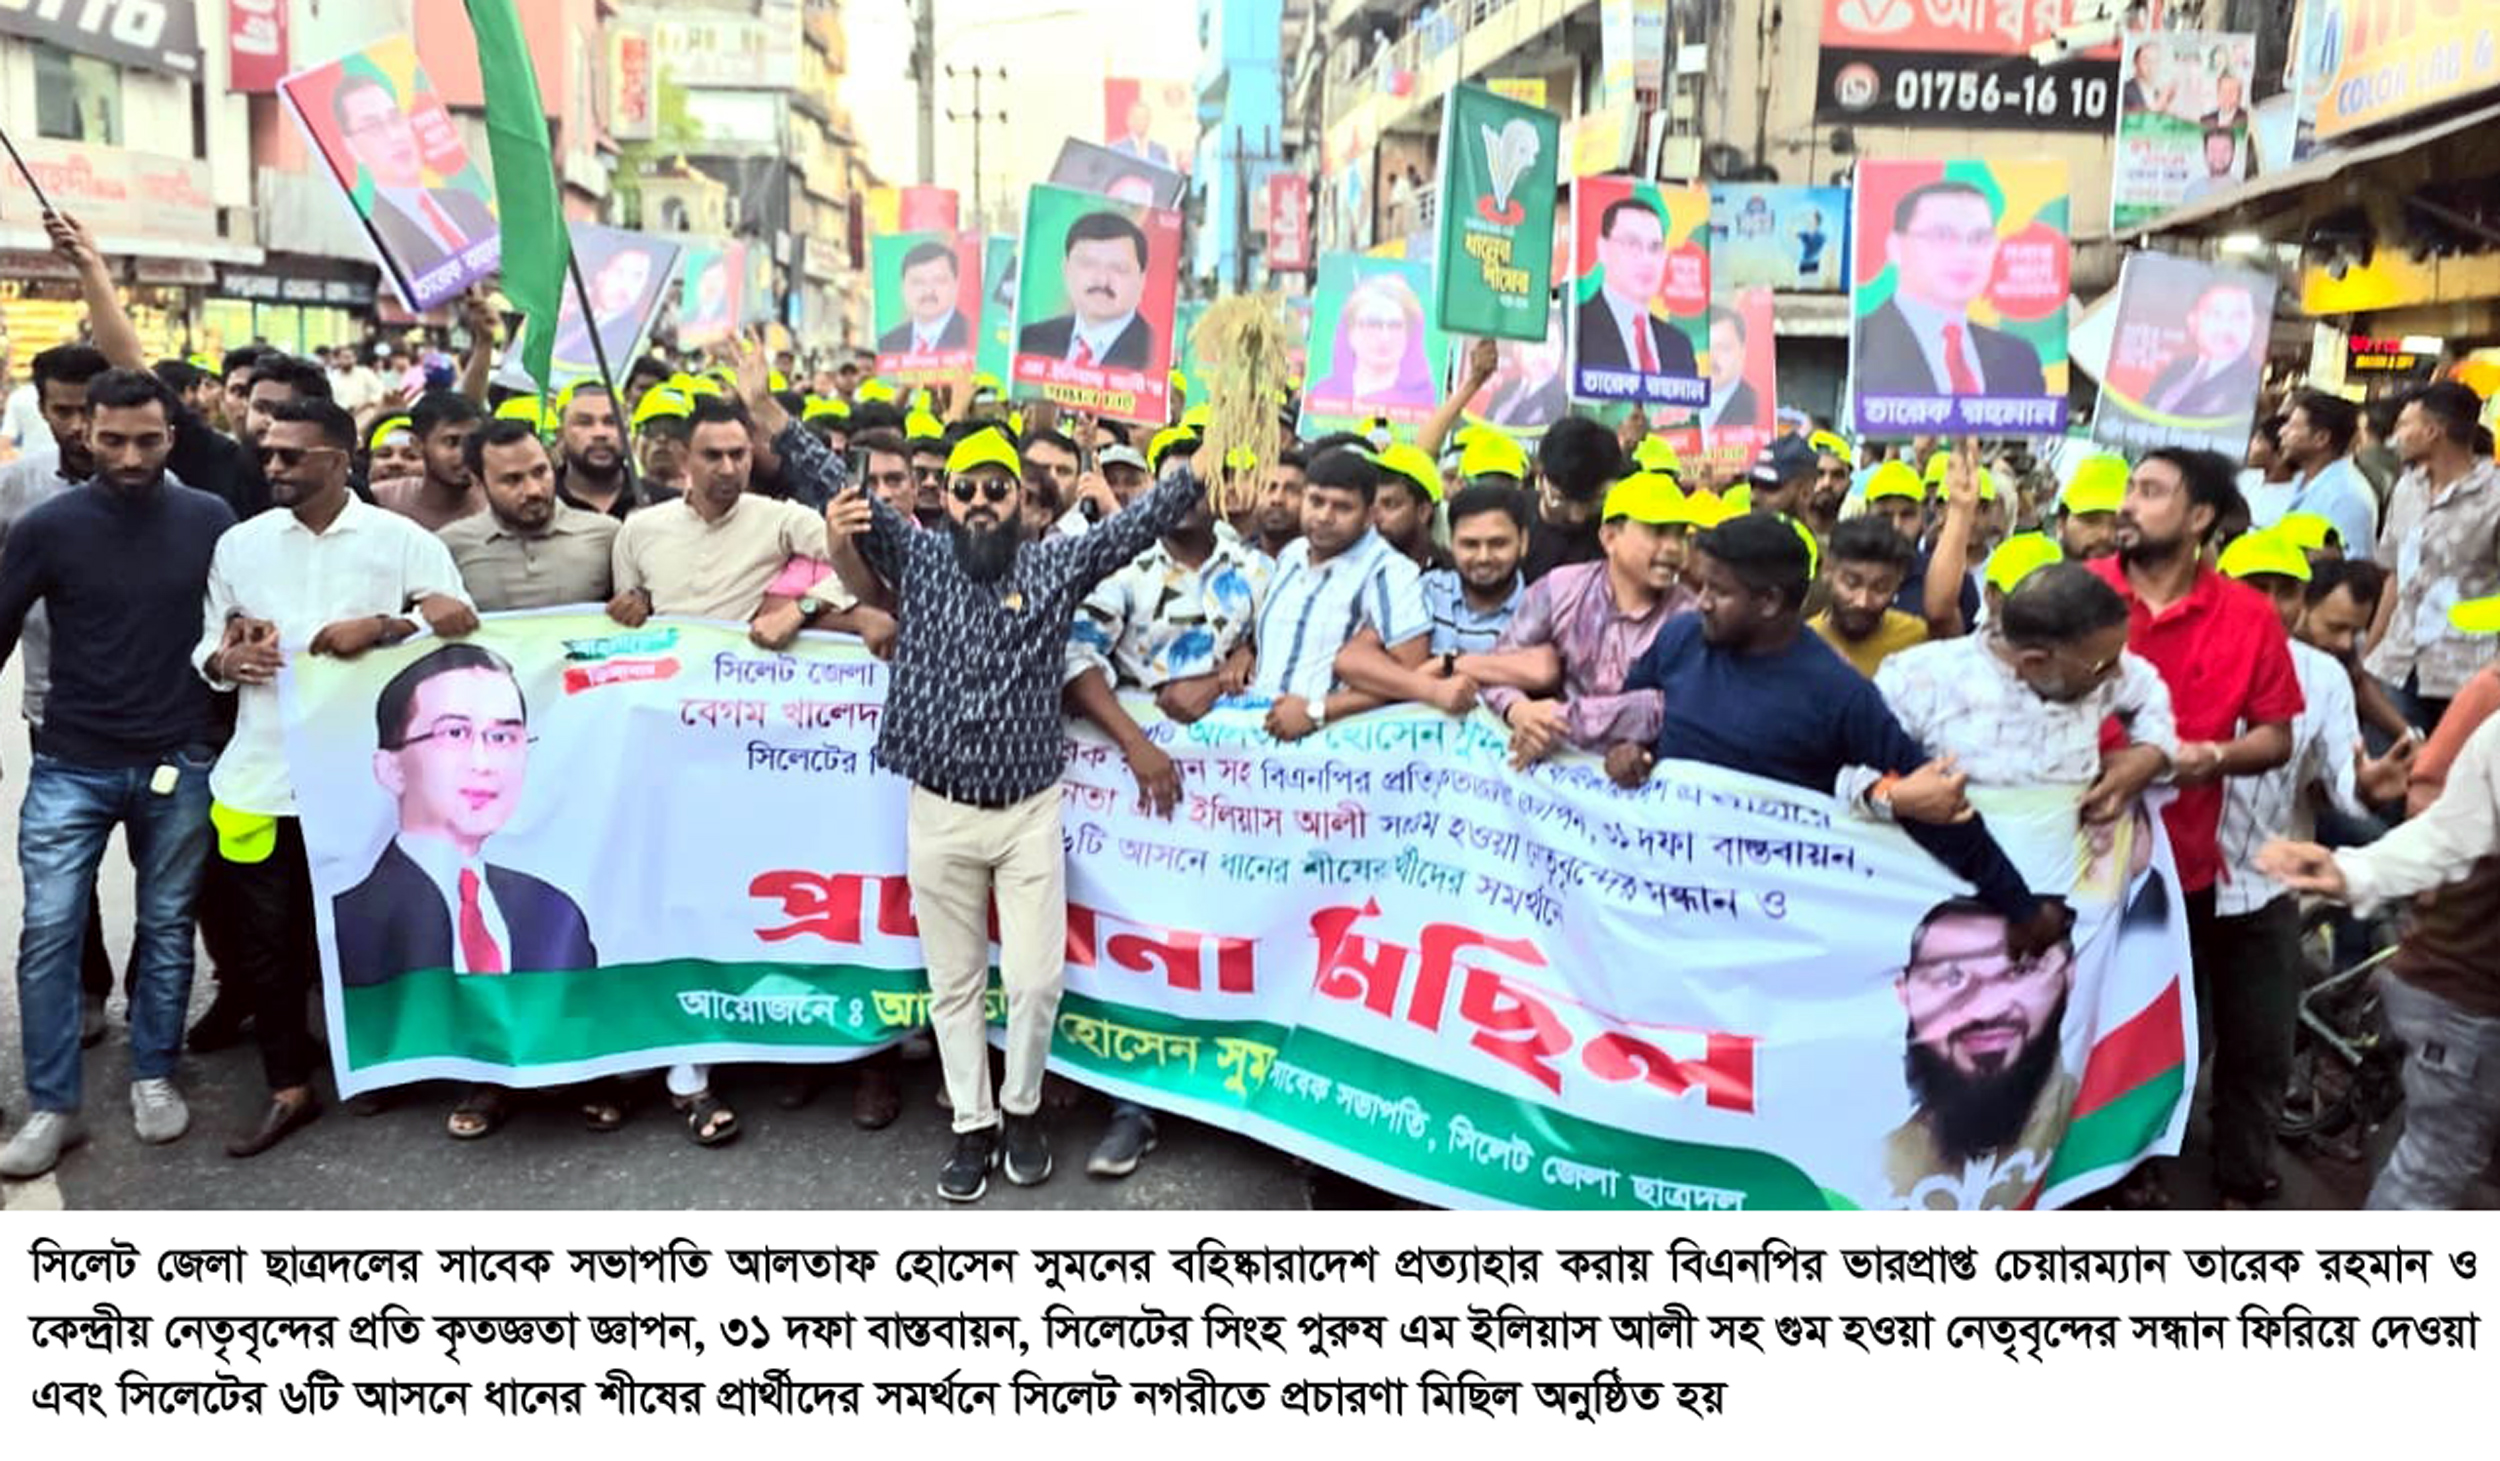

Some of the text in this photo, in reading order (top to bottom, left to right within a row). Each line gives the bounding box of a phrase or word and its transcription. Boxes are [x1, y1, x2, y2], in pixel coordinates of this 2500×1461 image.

[1896, 69, 2107, 117] 01756-16 10
[1582, 370, 1640, 395] তারেক
[1863, 396, 2058, 427] তারেক রহমান
[715, 652, 797, 684] সিলেট
[808, 660, 876, 685] জেলা
[681, 698, 769, 727] বেগম
[783, 700, 881, 730] খালেদ
[1262, 757, 1371, 794] বিএনপির
[1636, 823, 1693, 863] দফা
[747, 740, 857, 774] সিলেটের
[1189, 795, 1282, 836] ইলিয়াস
[1295, 799, 1367, 841] আলী
[1447, 813, 1520, 864] হওয়া
[1759, 889, 1788, 918] ও
[1117, 838, 1208, 875] আসনে
[1220, 850, 1292, 886] ধানের
[1308, 895, 1765, 1117] মিছিল
[678, 989, 838, 1029] আয়োজনে
[1057, 1012, 1198, 1072] হোসেন
[1335, 1080, 1438, 1153] সভাপতি,
[1447, 1114, 1534, 1172] সিলেট
[1540, 1153, 1619, 1199] জেলা
